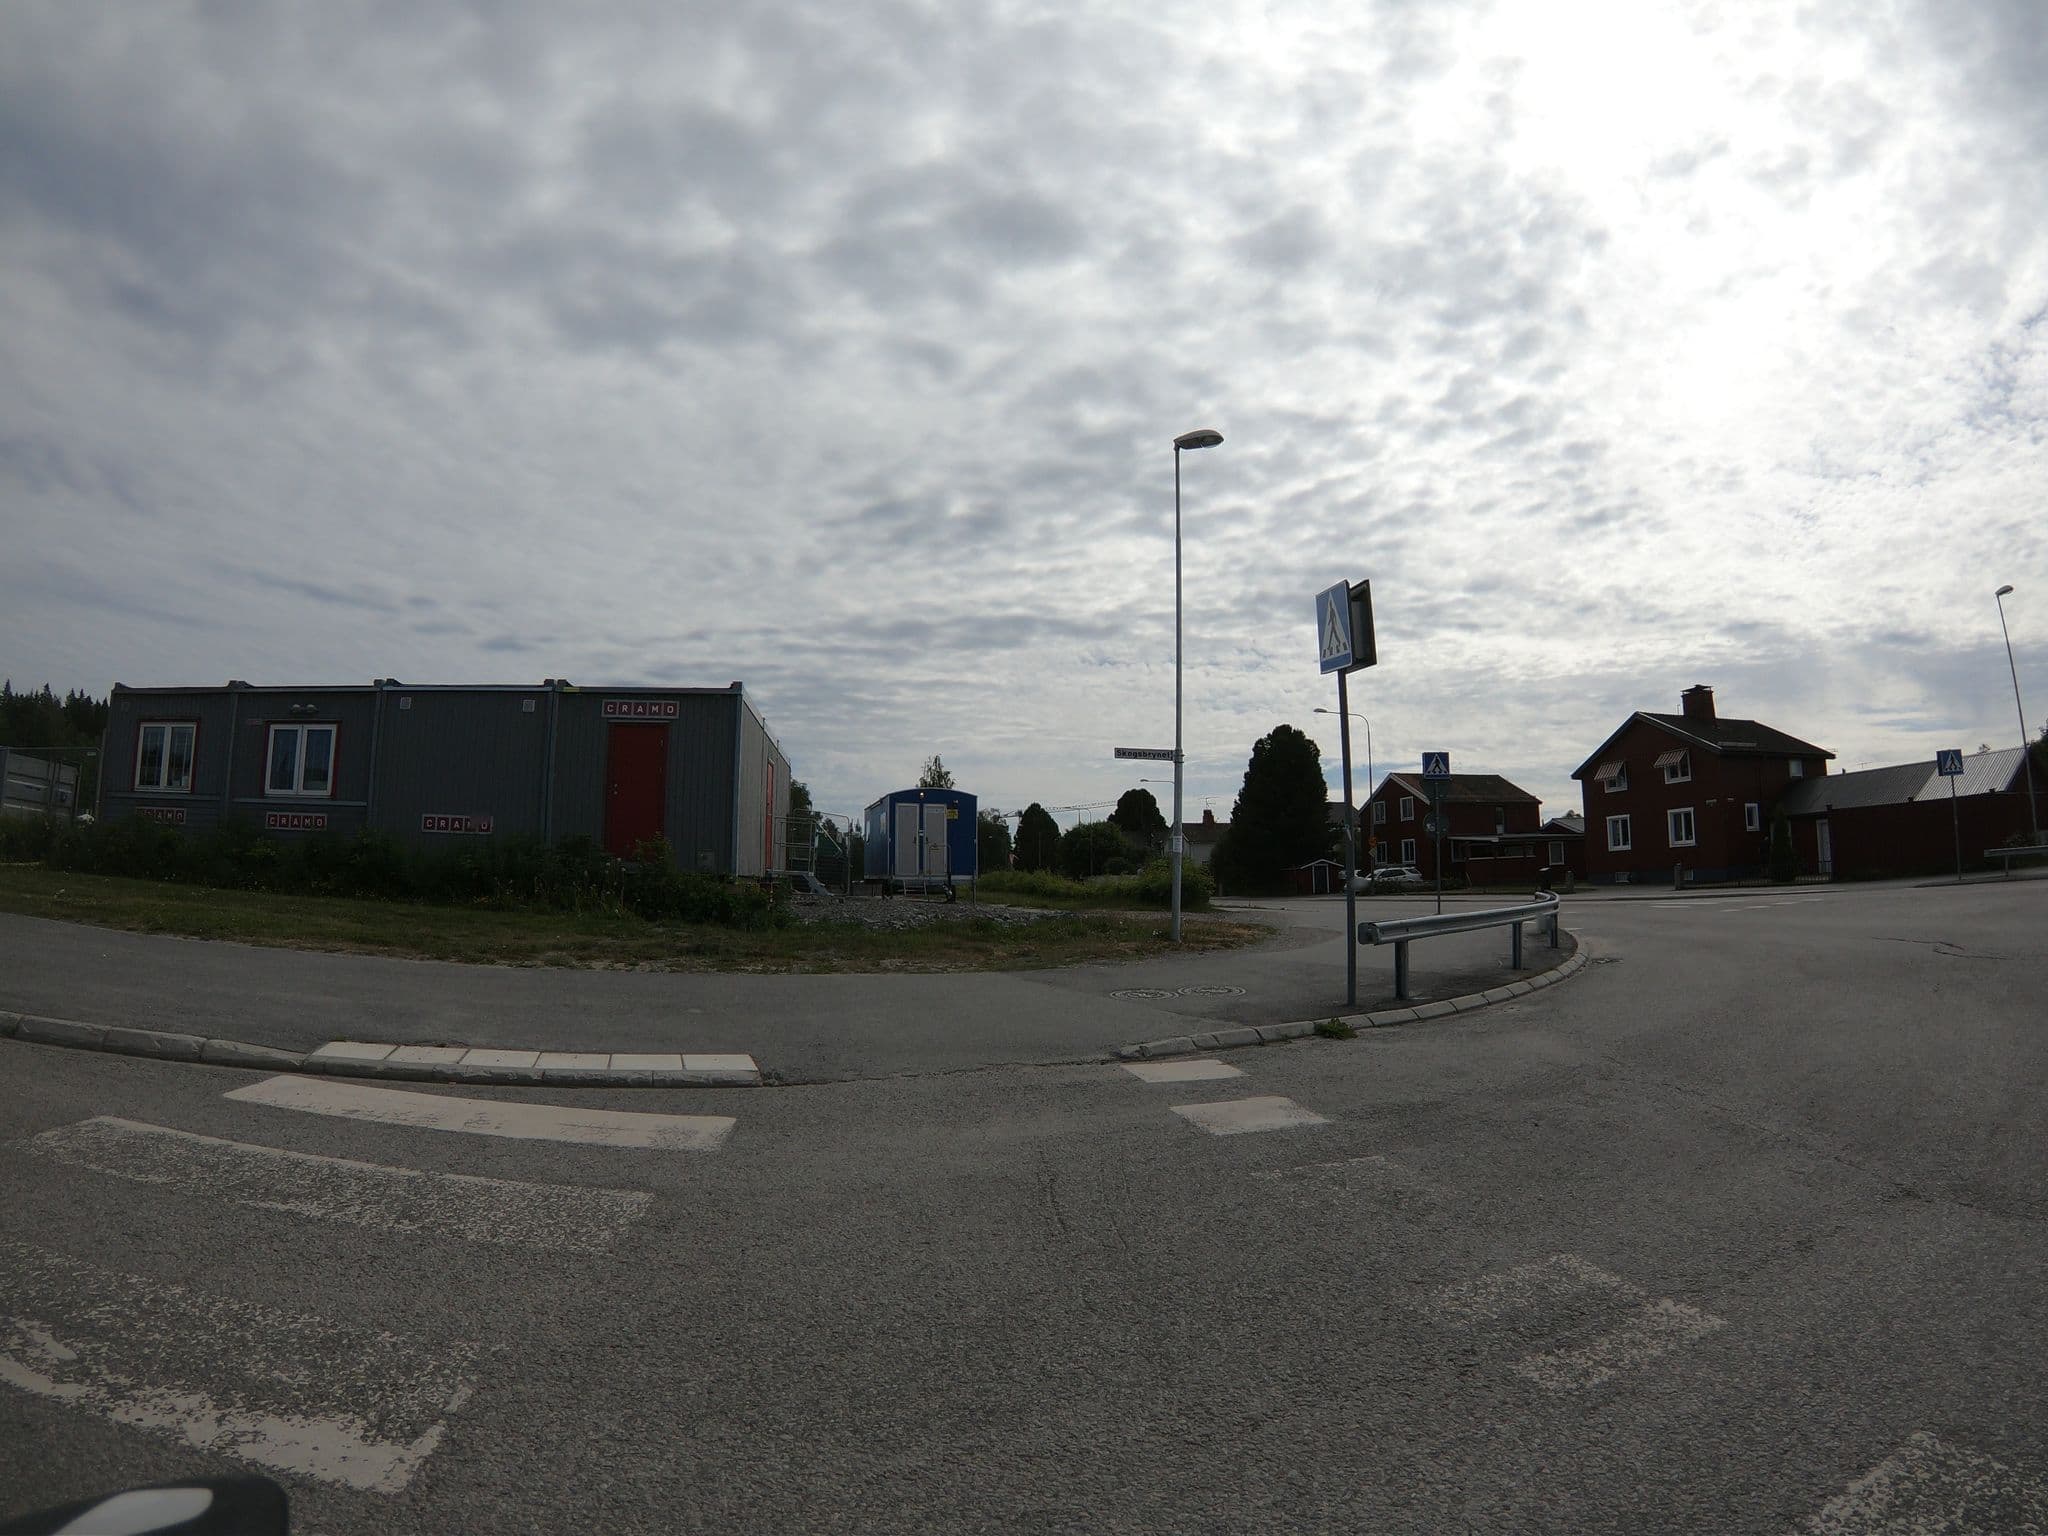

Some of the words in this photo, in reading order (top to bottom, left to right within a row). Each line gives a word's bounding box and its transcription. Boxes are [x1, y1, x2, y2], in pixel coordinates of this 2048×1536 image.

[606, 704, 675, 714] CRAMO
[1116, 749, 1170, 759] Skogsbrynet
[269, 816, 323, 827] CRAMO
[426, 819, 488, 830] CRAO
